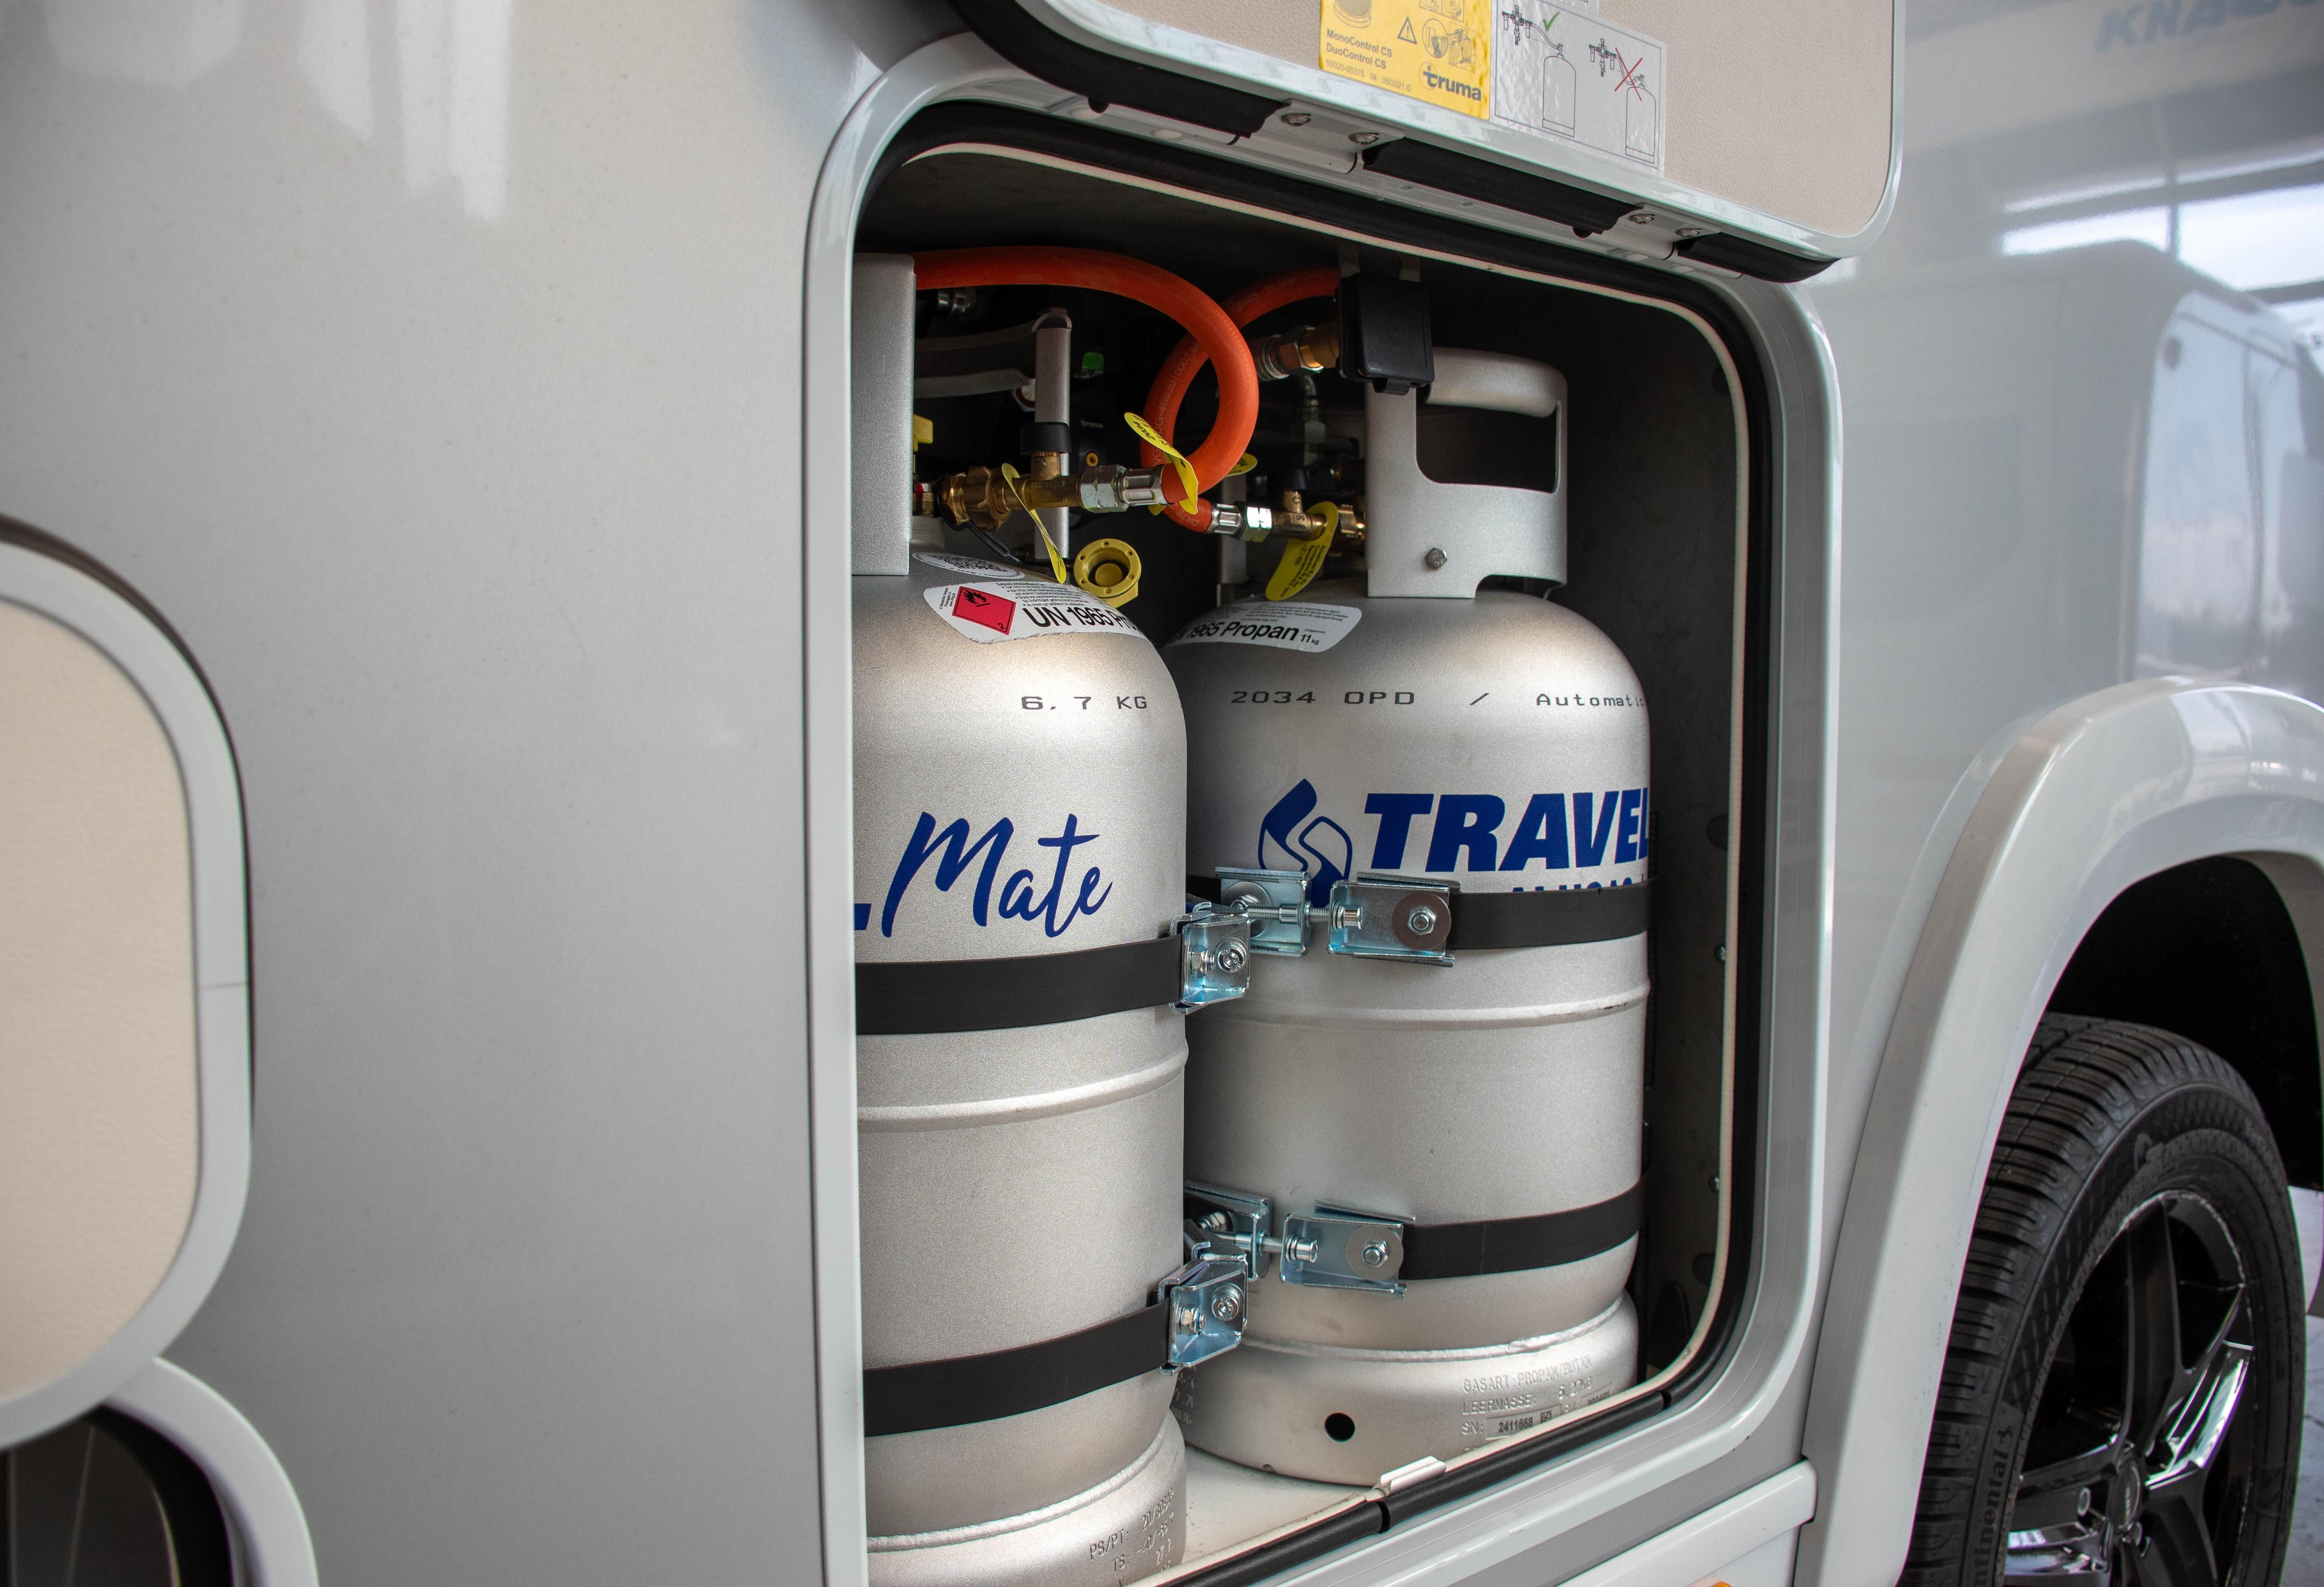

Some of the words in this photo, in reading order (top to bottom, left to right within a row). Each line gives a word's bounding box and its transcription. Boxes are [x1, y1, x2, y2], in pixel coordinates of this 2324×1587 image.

[2097, 0, 2318, 51] KNA
[1326, 29, 1379, 53] MonoControl
[1381, 46, 1392, 58] CS
[1326, 43, 1372, 65] DuoControl
[1375, 58, 1386, 69] CS
[1326, 59, 1365, 78] 50020-00375
[1369, 73, 1377, 82] 04
[1382, 77, 1404, 90] 05/2021
[1423, 70, 1481, 102] truma
[1022, 607, 1072, 628] UN
[1066, 607, 1115, 626] 1965
[1220, 621, 1299, 641] Propan
[1116, 696, 1147, 709] KG
[1231, 691, 1316, 705] 2034
[1344, 691, 1415, 705] OPD
[1470, 693, 1489, 705] /
[881, 811, 1113, 938] Mate
[1462, 1393, 1537, 1415] LEERMASSE:
[1461, 1420, 1484, 1436] SN:
[1498, 1416, 1534, 1433] 2411668
[1090, 1528, 1129, 1560] PS/PT:
[1112, 1554, 1130, 1573] TS:
